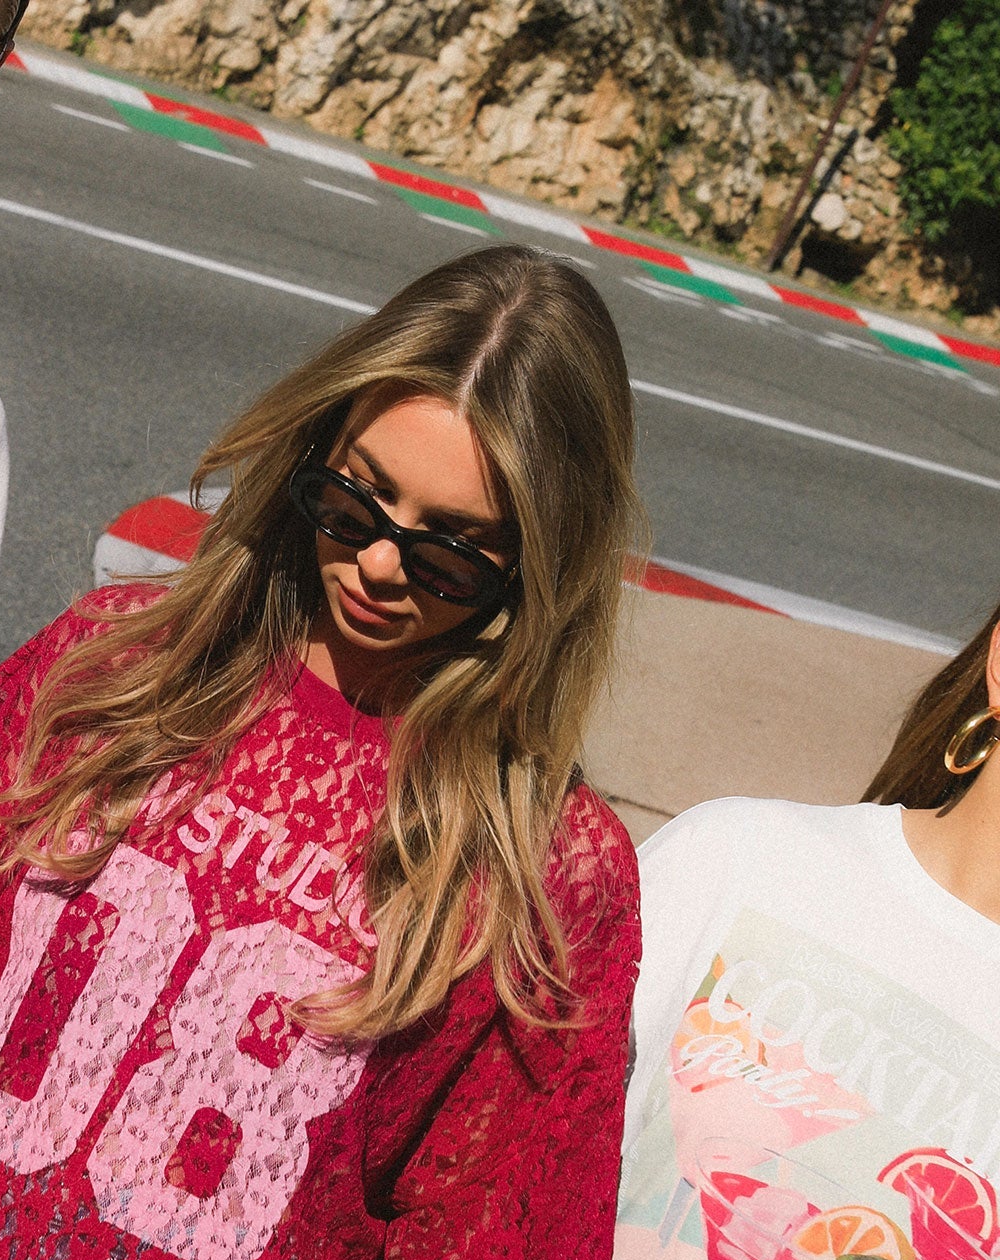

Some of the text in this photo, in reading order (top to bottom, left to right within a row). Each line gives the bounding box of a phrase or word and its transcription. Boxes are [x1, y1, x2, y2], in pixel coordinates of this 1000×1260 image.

[787, 945, 889, 1008] MOST
[666, 1033, 861, 1121] Party!
[708, 959, 1000, 1188] COCKTAI
